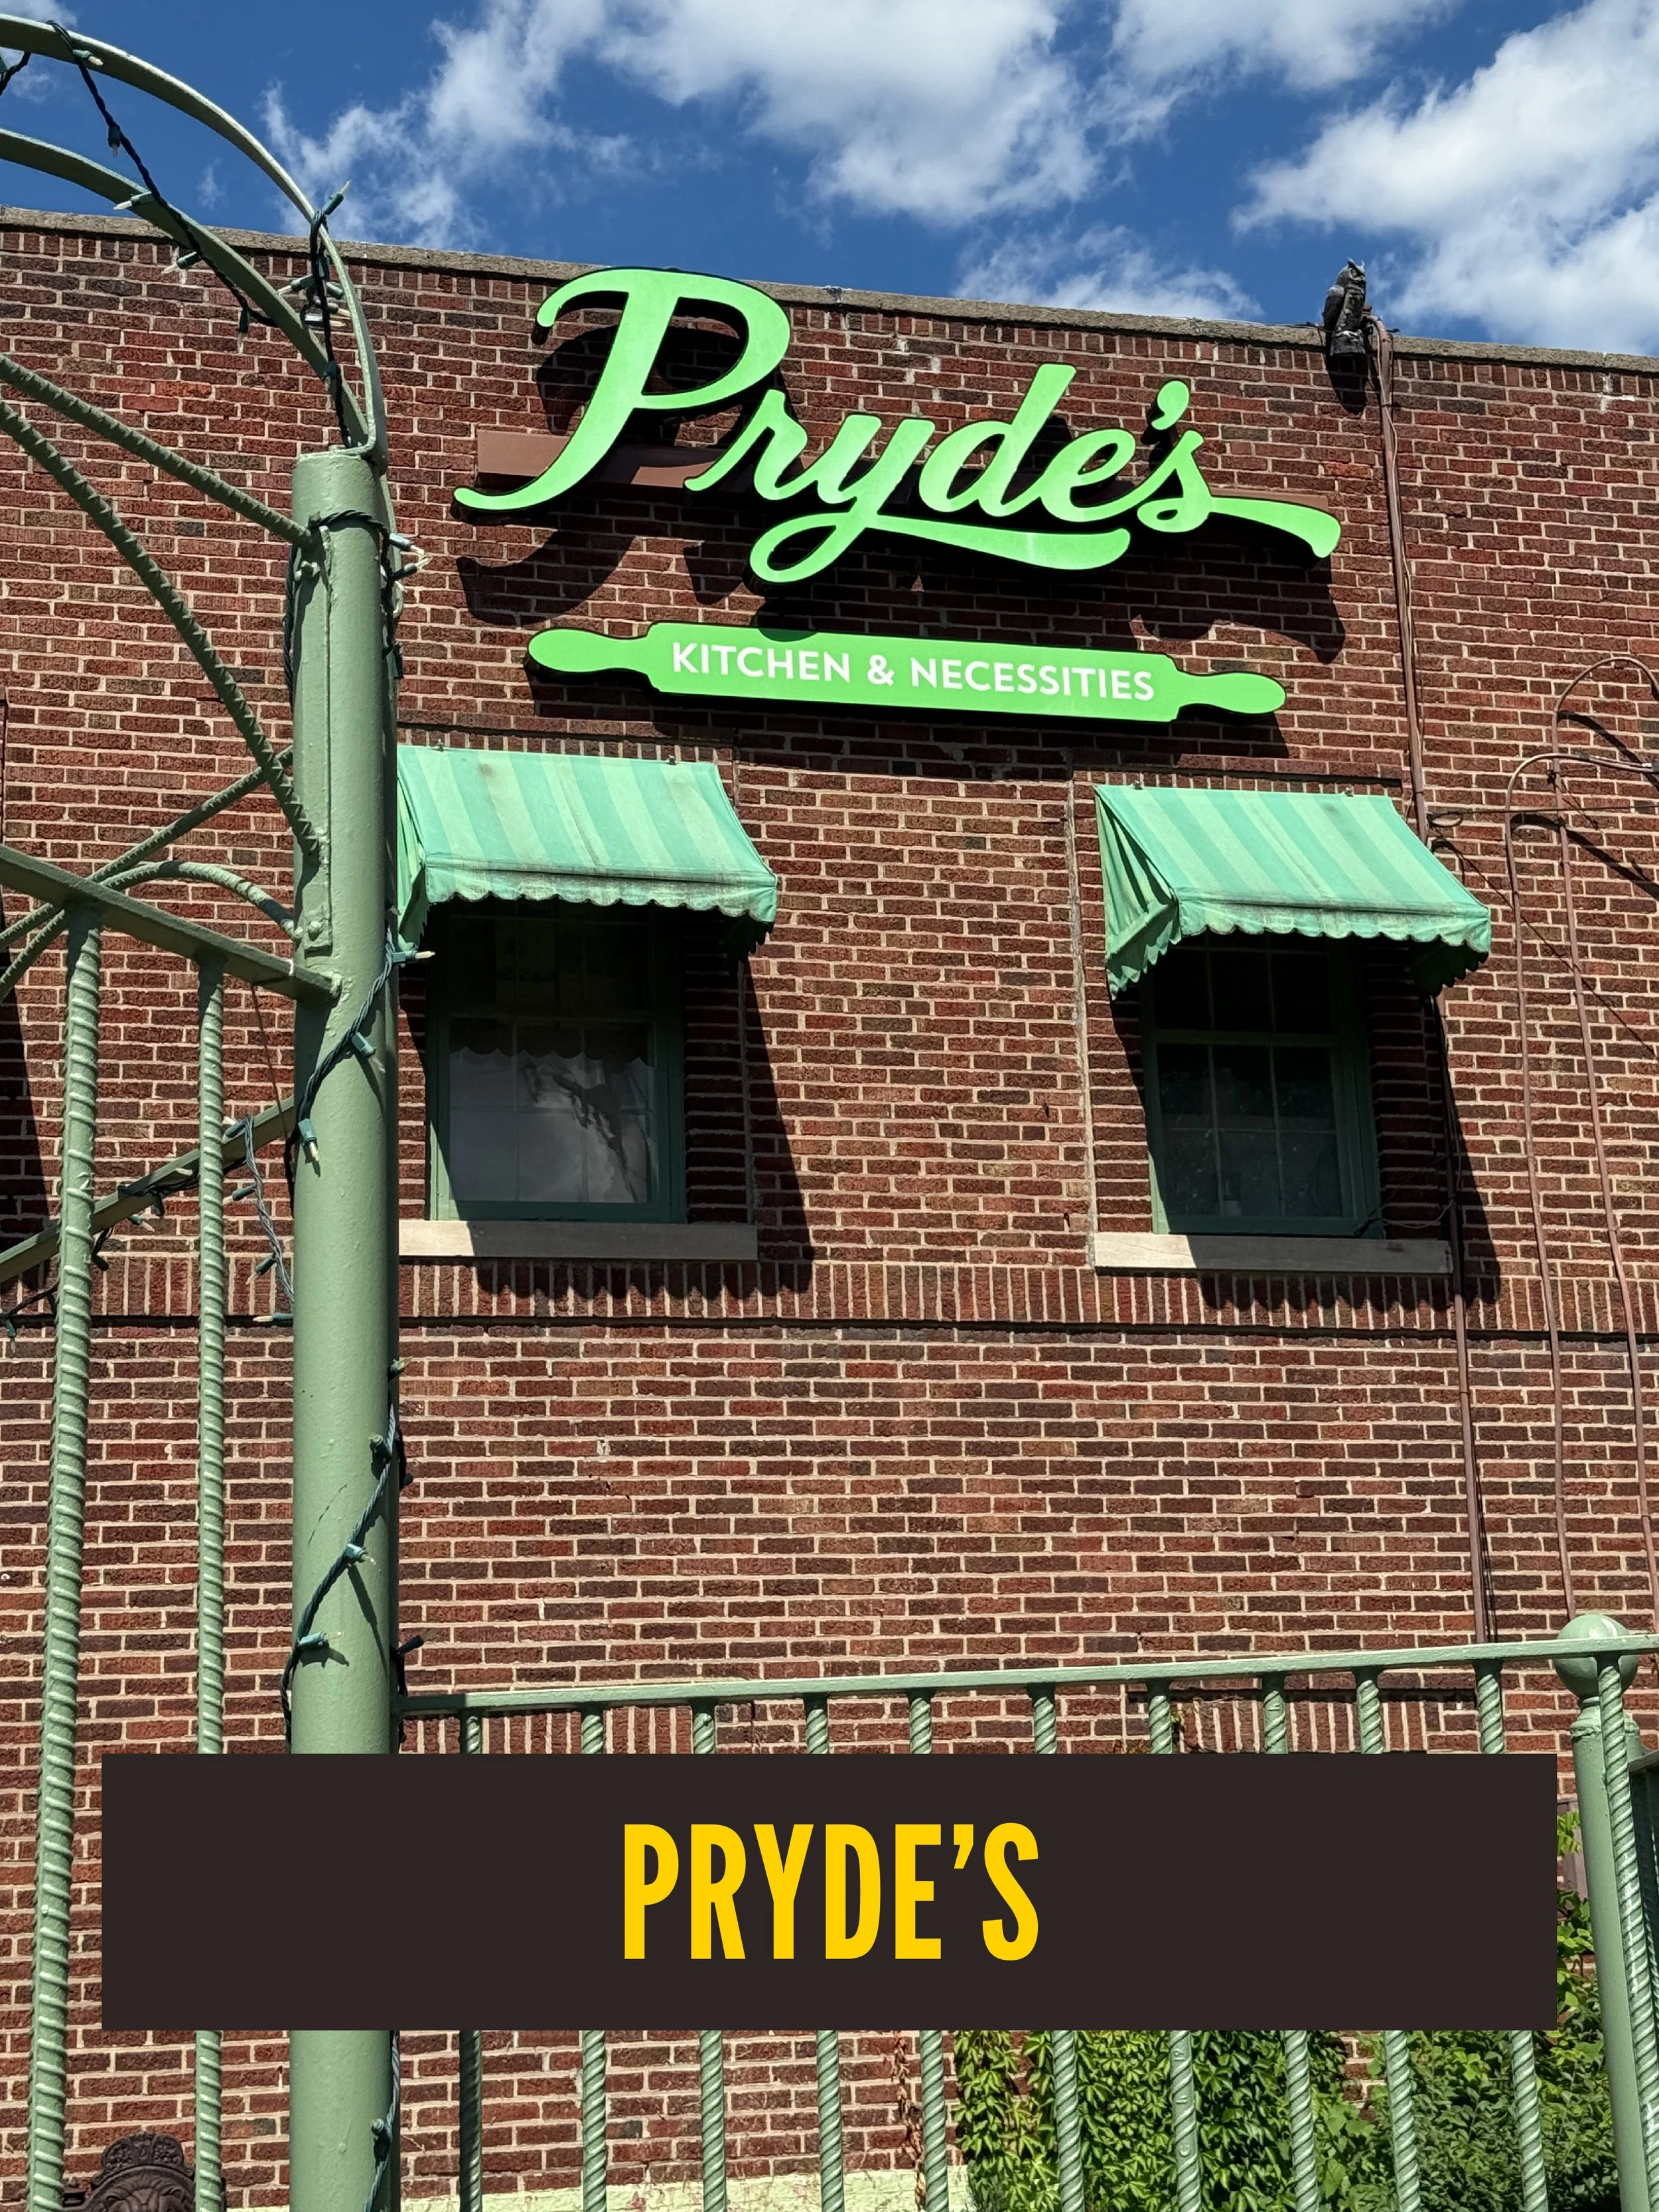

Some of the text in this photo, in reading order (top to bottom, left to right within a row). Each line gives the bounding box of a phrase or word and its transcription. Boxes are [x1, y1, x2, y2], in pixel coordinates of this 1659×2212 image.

[455, 268, 1340, 584] Pryde's
[673, 642, 1155, 701] KITCHEN & NECESSITIES
